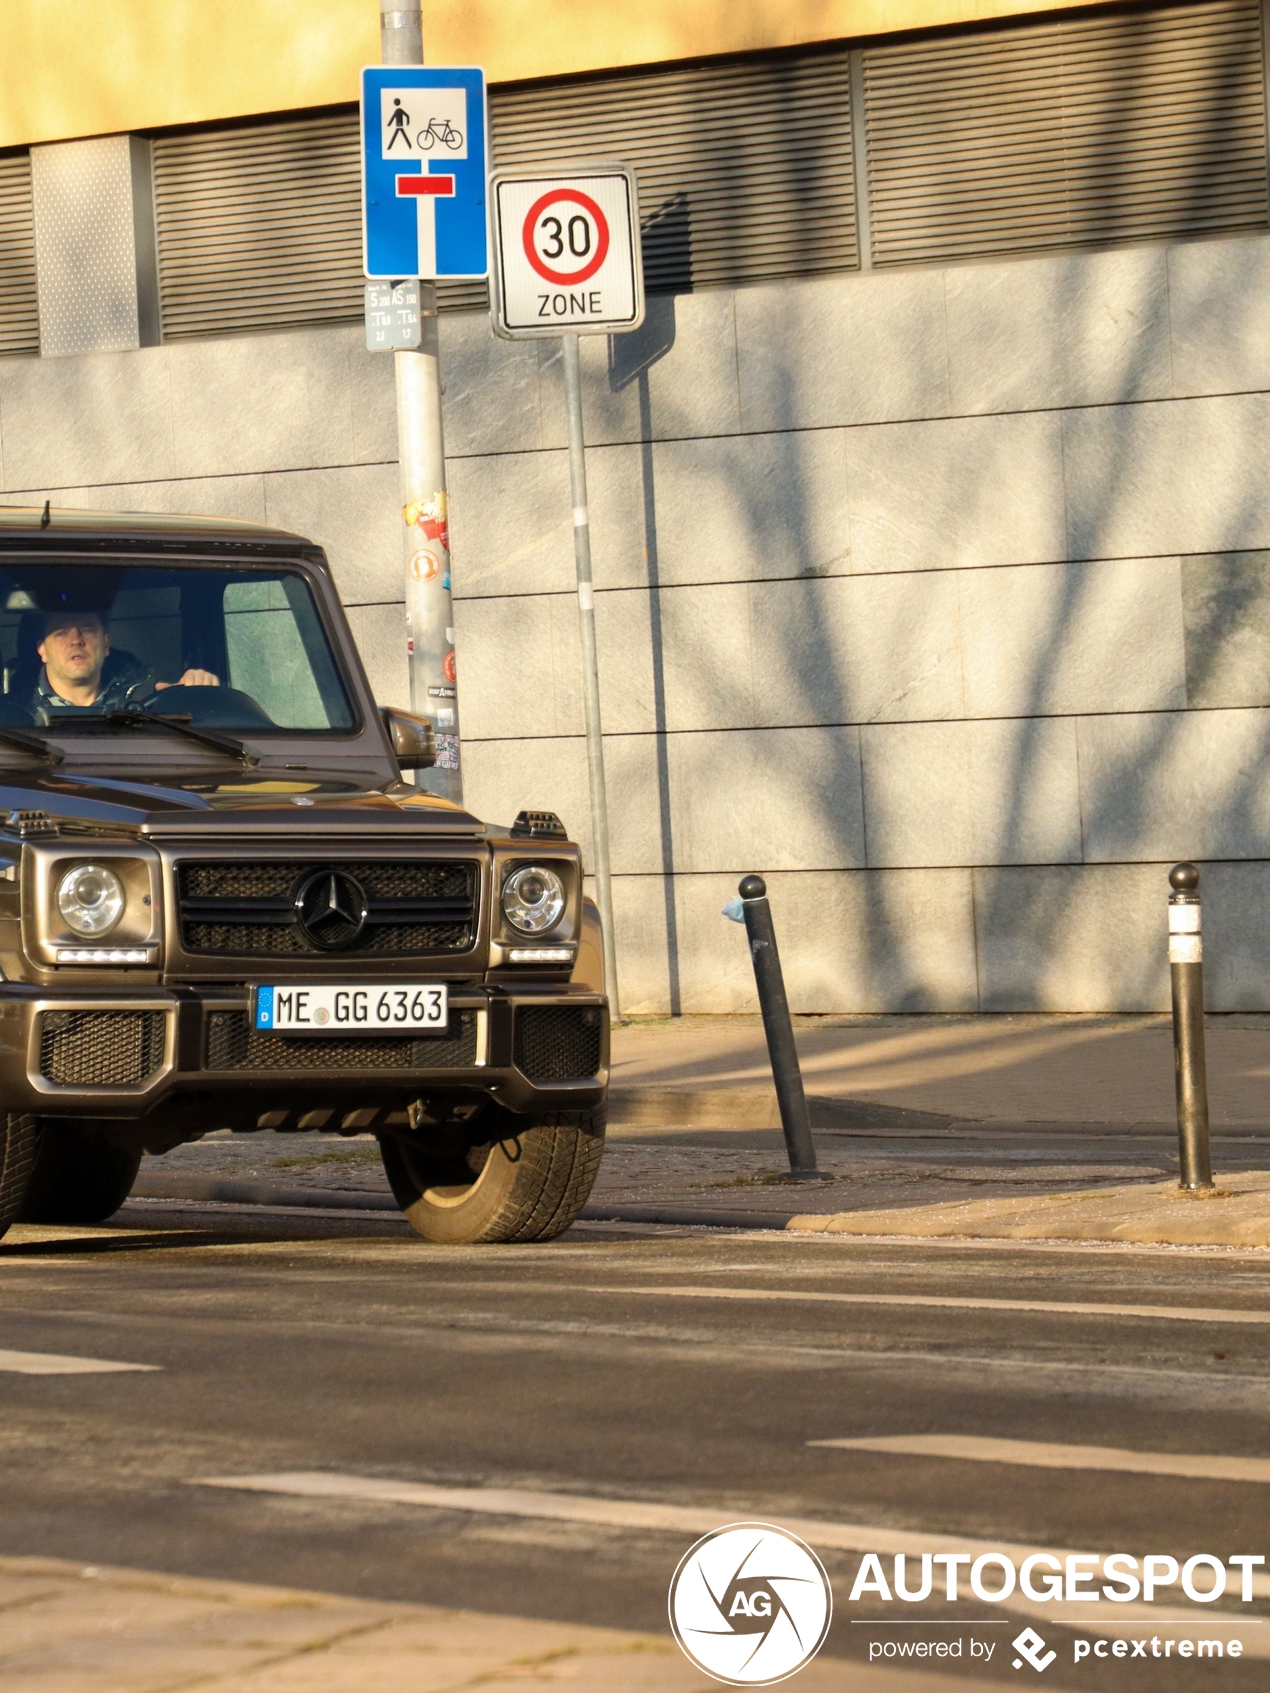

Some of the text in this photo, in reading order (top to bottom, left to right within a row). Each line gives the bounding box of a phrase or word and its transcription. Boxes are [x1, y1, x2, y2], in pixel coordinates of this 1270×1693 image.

[540, 215, 590, 259] 30
[538, 291, 603, 317] ZONE
[260, 1012, 269, 1022] D
[276, 990, 442, 1023] ME GG 6363
